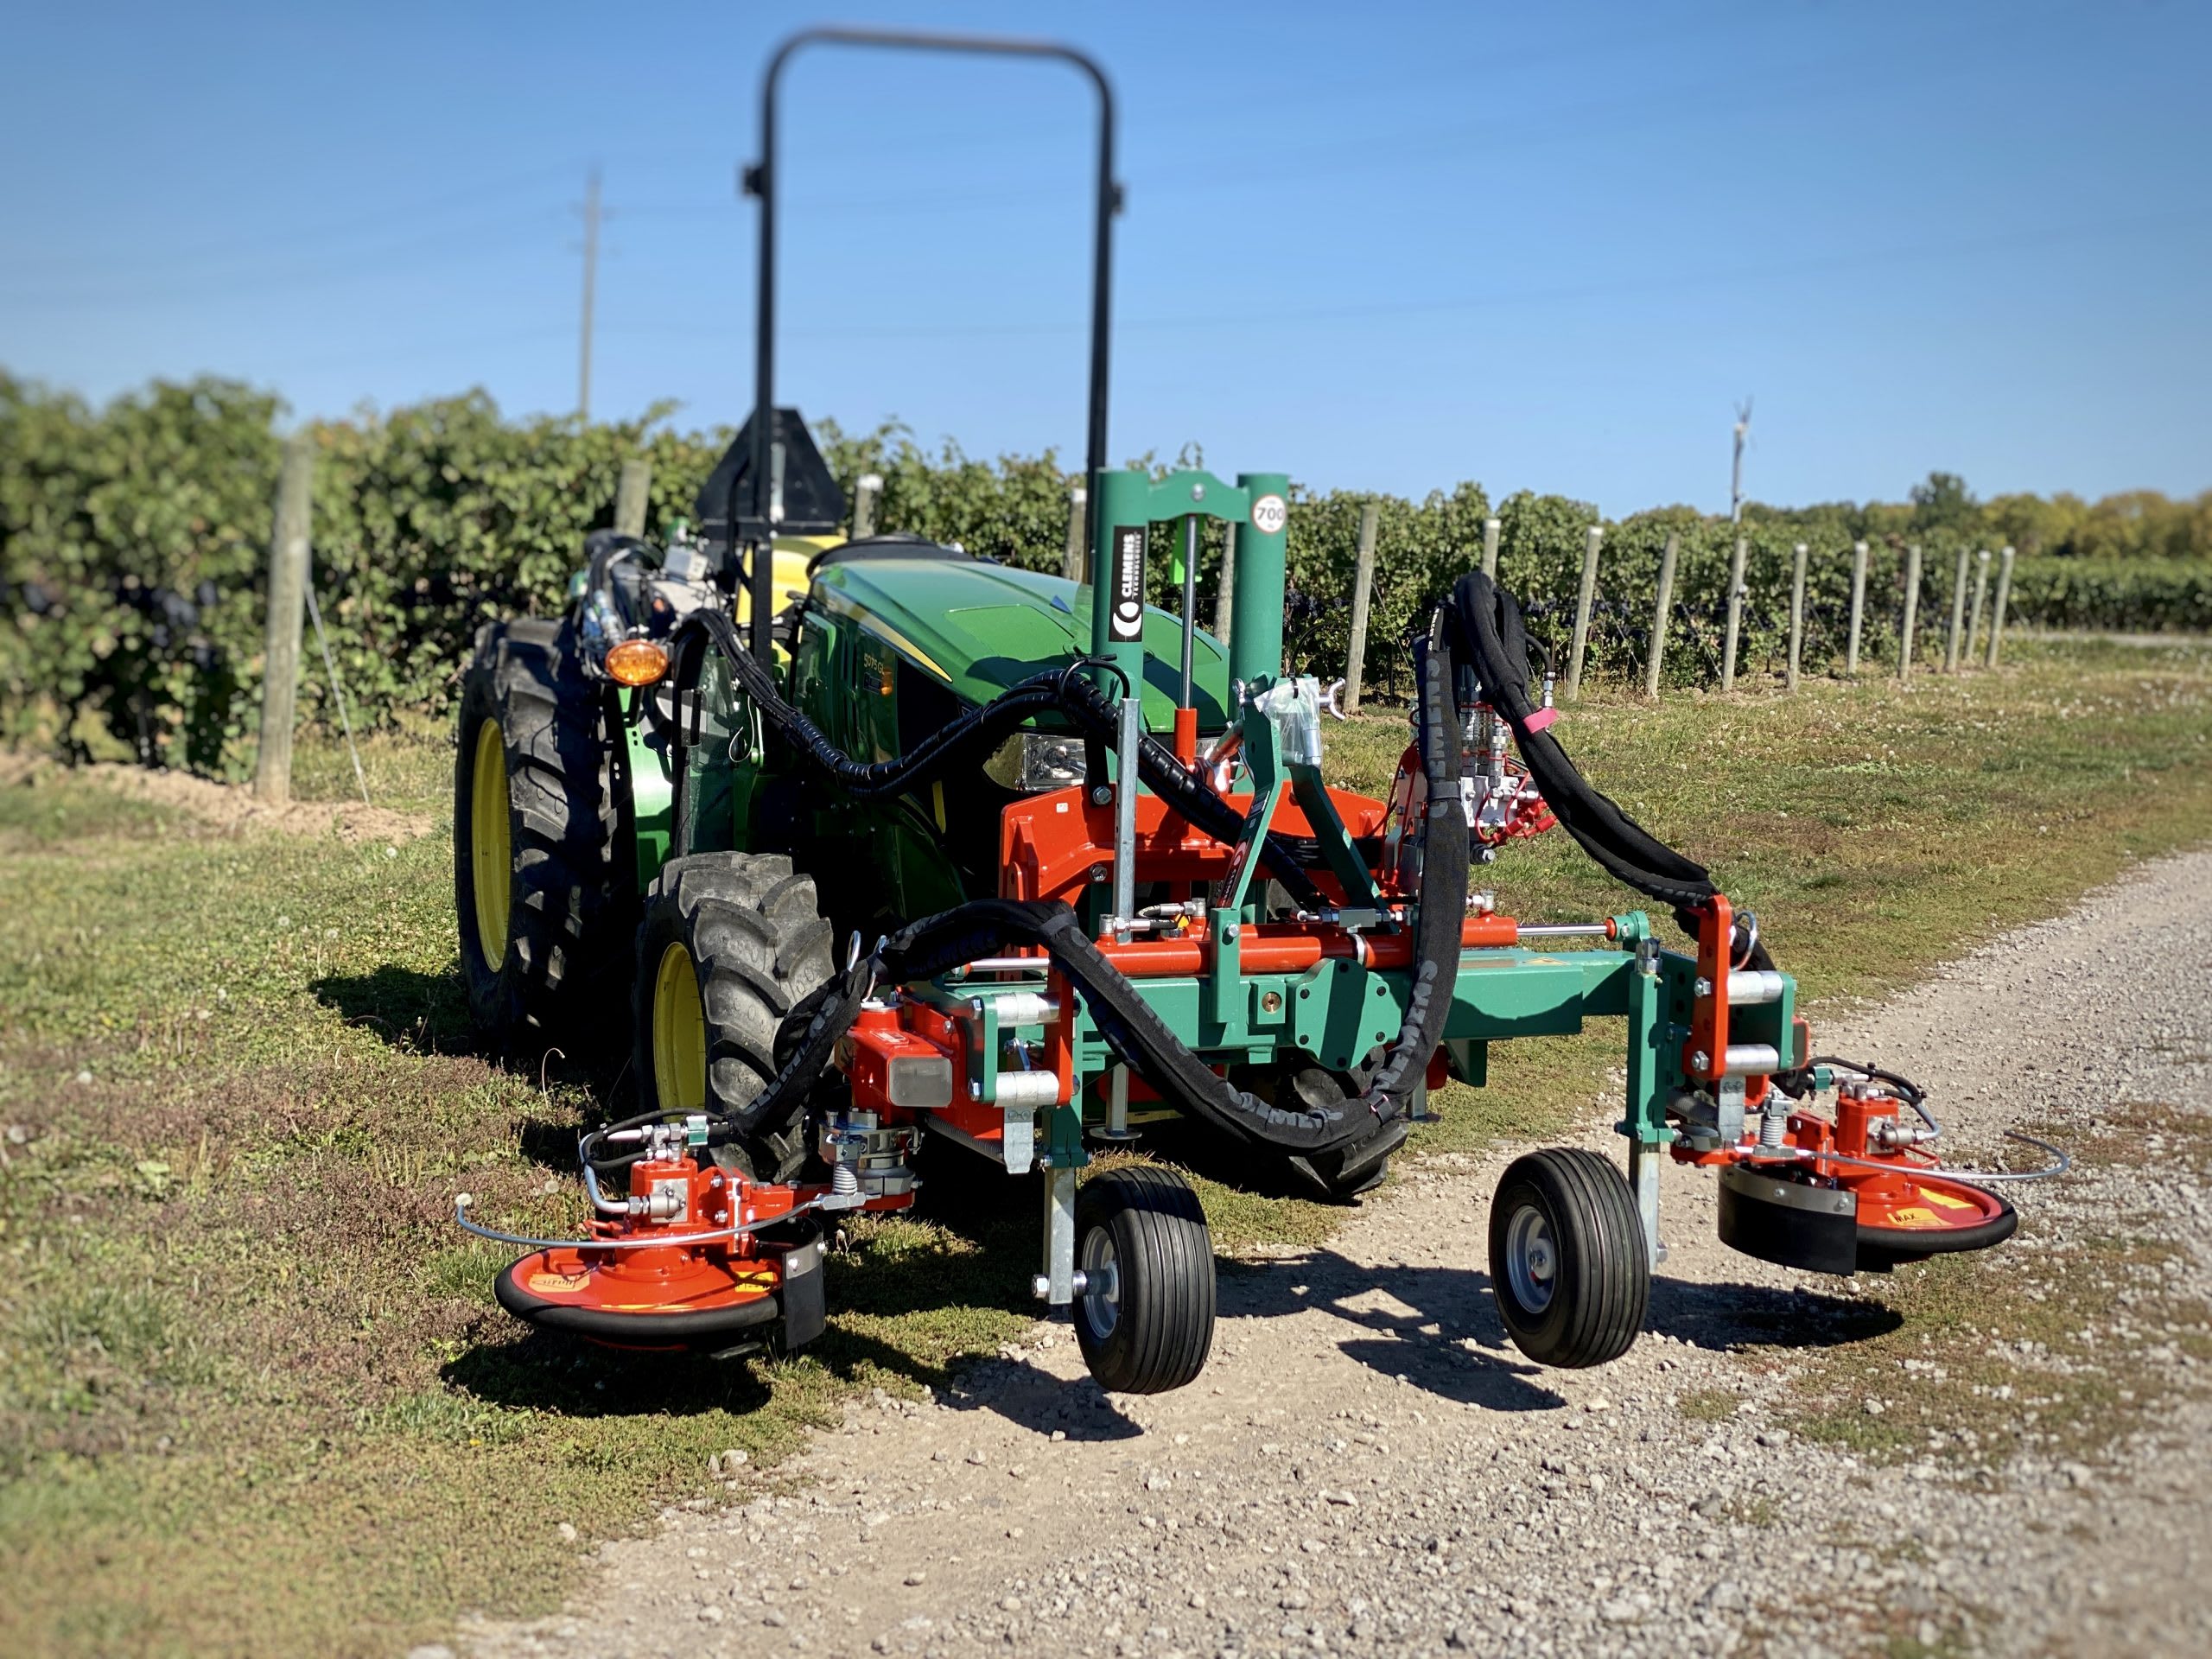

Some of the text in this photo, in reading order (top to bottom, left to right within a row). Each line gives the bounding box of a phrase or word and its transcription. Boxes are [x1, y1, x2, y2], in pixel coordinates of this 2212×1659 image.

[1257, 507, 1286, 521] 700
[1122, 533, 1135, 597] CLEMENS
[1426, 658, 1449, 818] CEMENS
